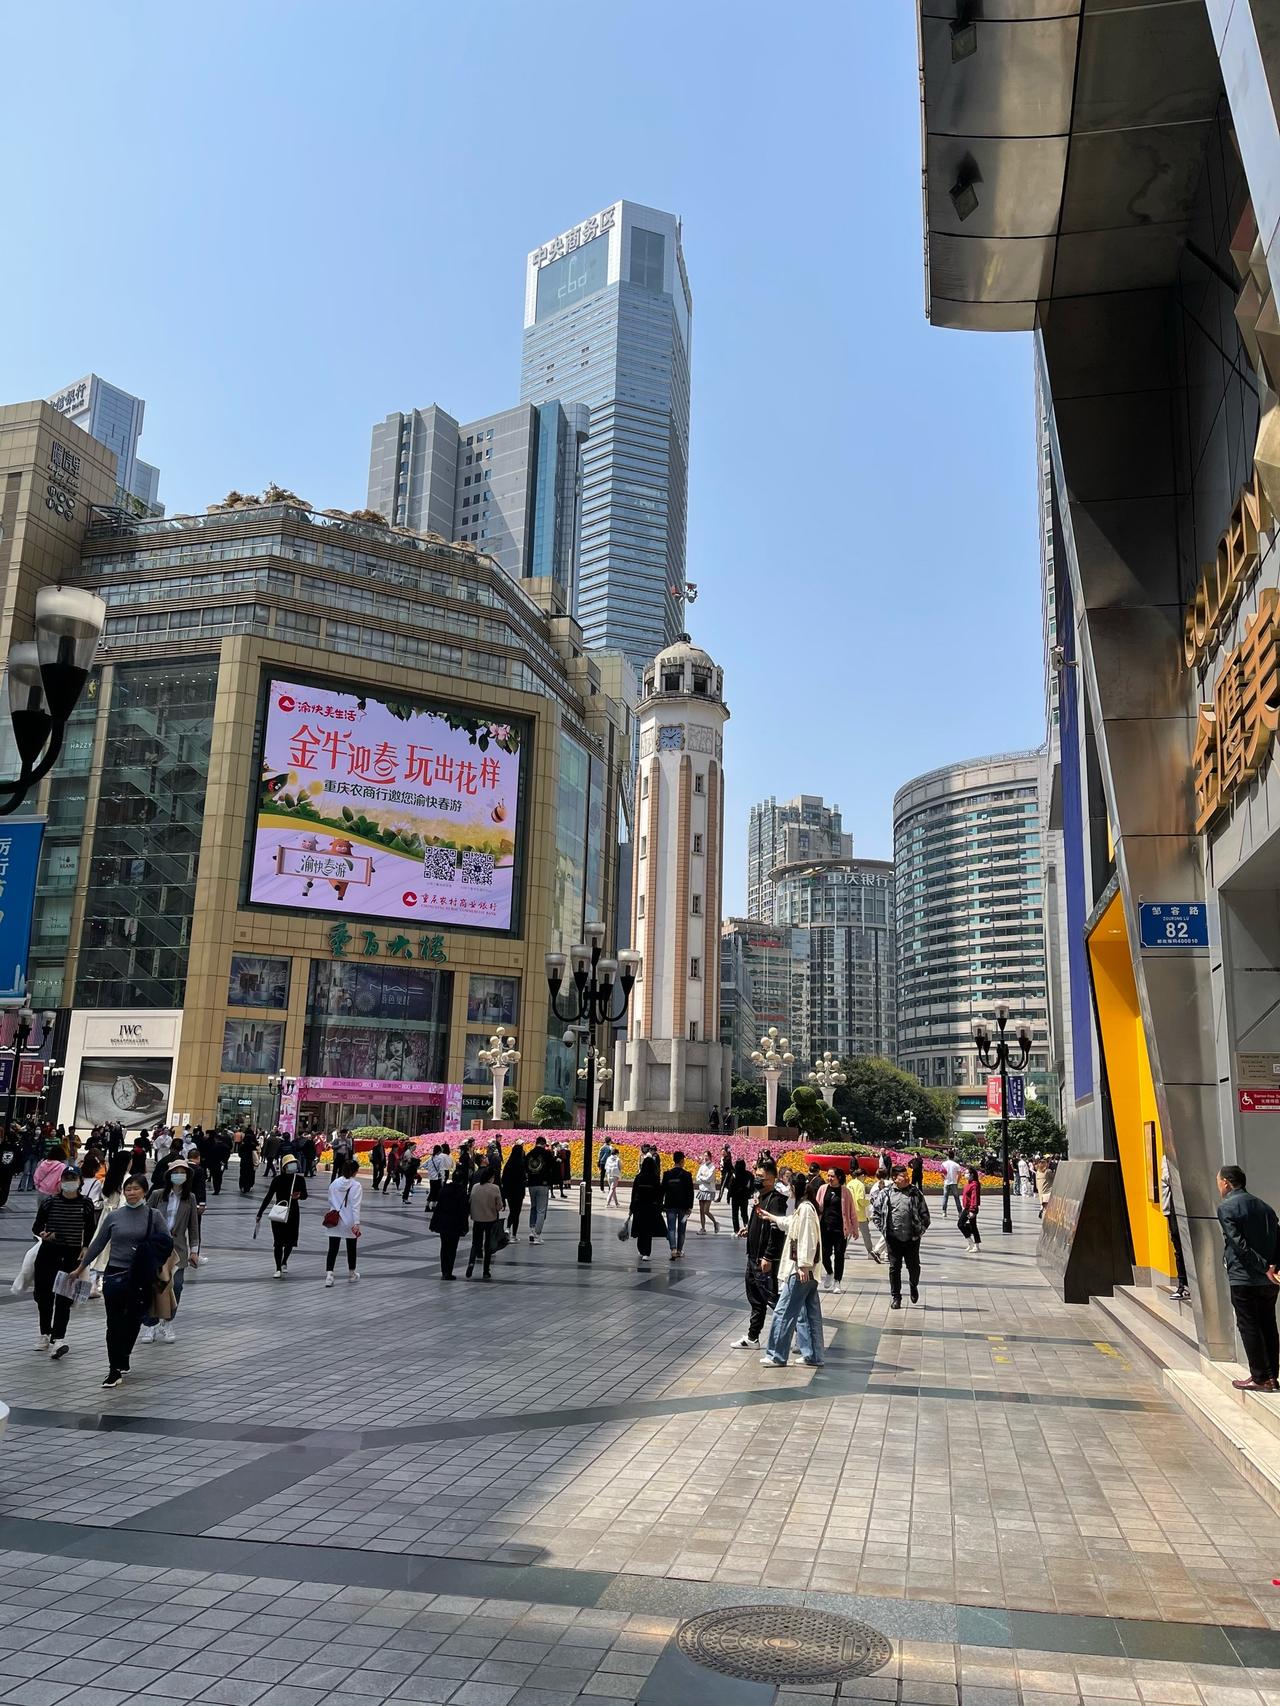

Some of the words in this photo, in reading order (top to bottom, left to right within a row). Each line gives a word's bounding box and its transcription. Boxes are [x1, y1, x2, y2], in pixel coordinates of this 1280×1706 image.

[533, 206, 615, 268] 中央商务区
[298, 701, 357, 722] 渝快美生活
[287, 724, 400, 785] 金牛迎春
[404, 743, 501, 796] 玩出花样
[323, 779, 463, 813] 重庆农商行邀您渝快春游
[827, 872, 889, 888] 重庆银行
[327, 921, 448, 964] 重百大楼
[1166, 922, 1189, 938] 82
[119, 1024, 143, 1036] IWC
